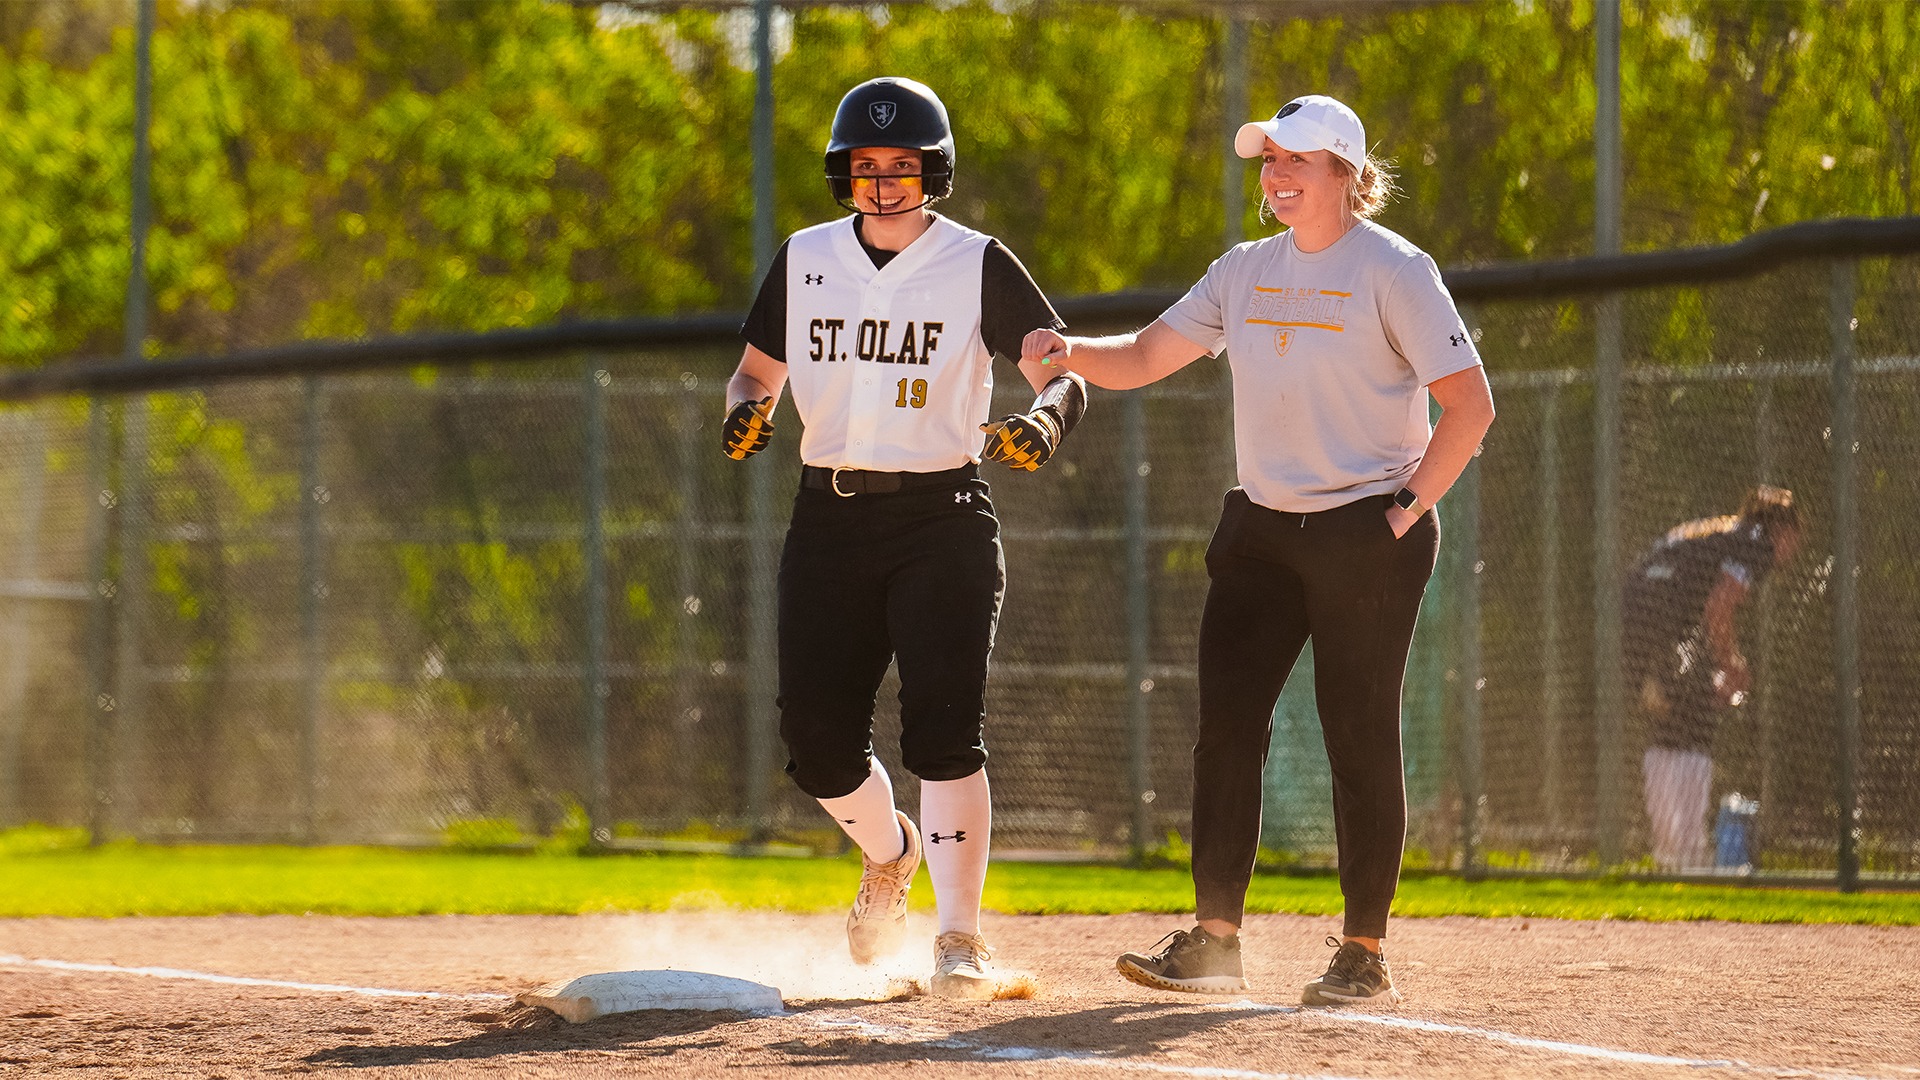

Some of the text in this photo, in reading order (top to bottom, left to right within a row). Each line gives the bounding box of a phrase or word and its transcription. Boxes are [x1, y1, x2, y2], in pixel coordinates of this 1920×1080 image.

[1298, 287, 1317, 297] OLAF
[1247, 294, 1345, 326] SOFTBALL
[809, 318, 944, 365] ST. OLAF
[895, 377, 928, 409] 19
